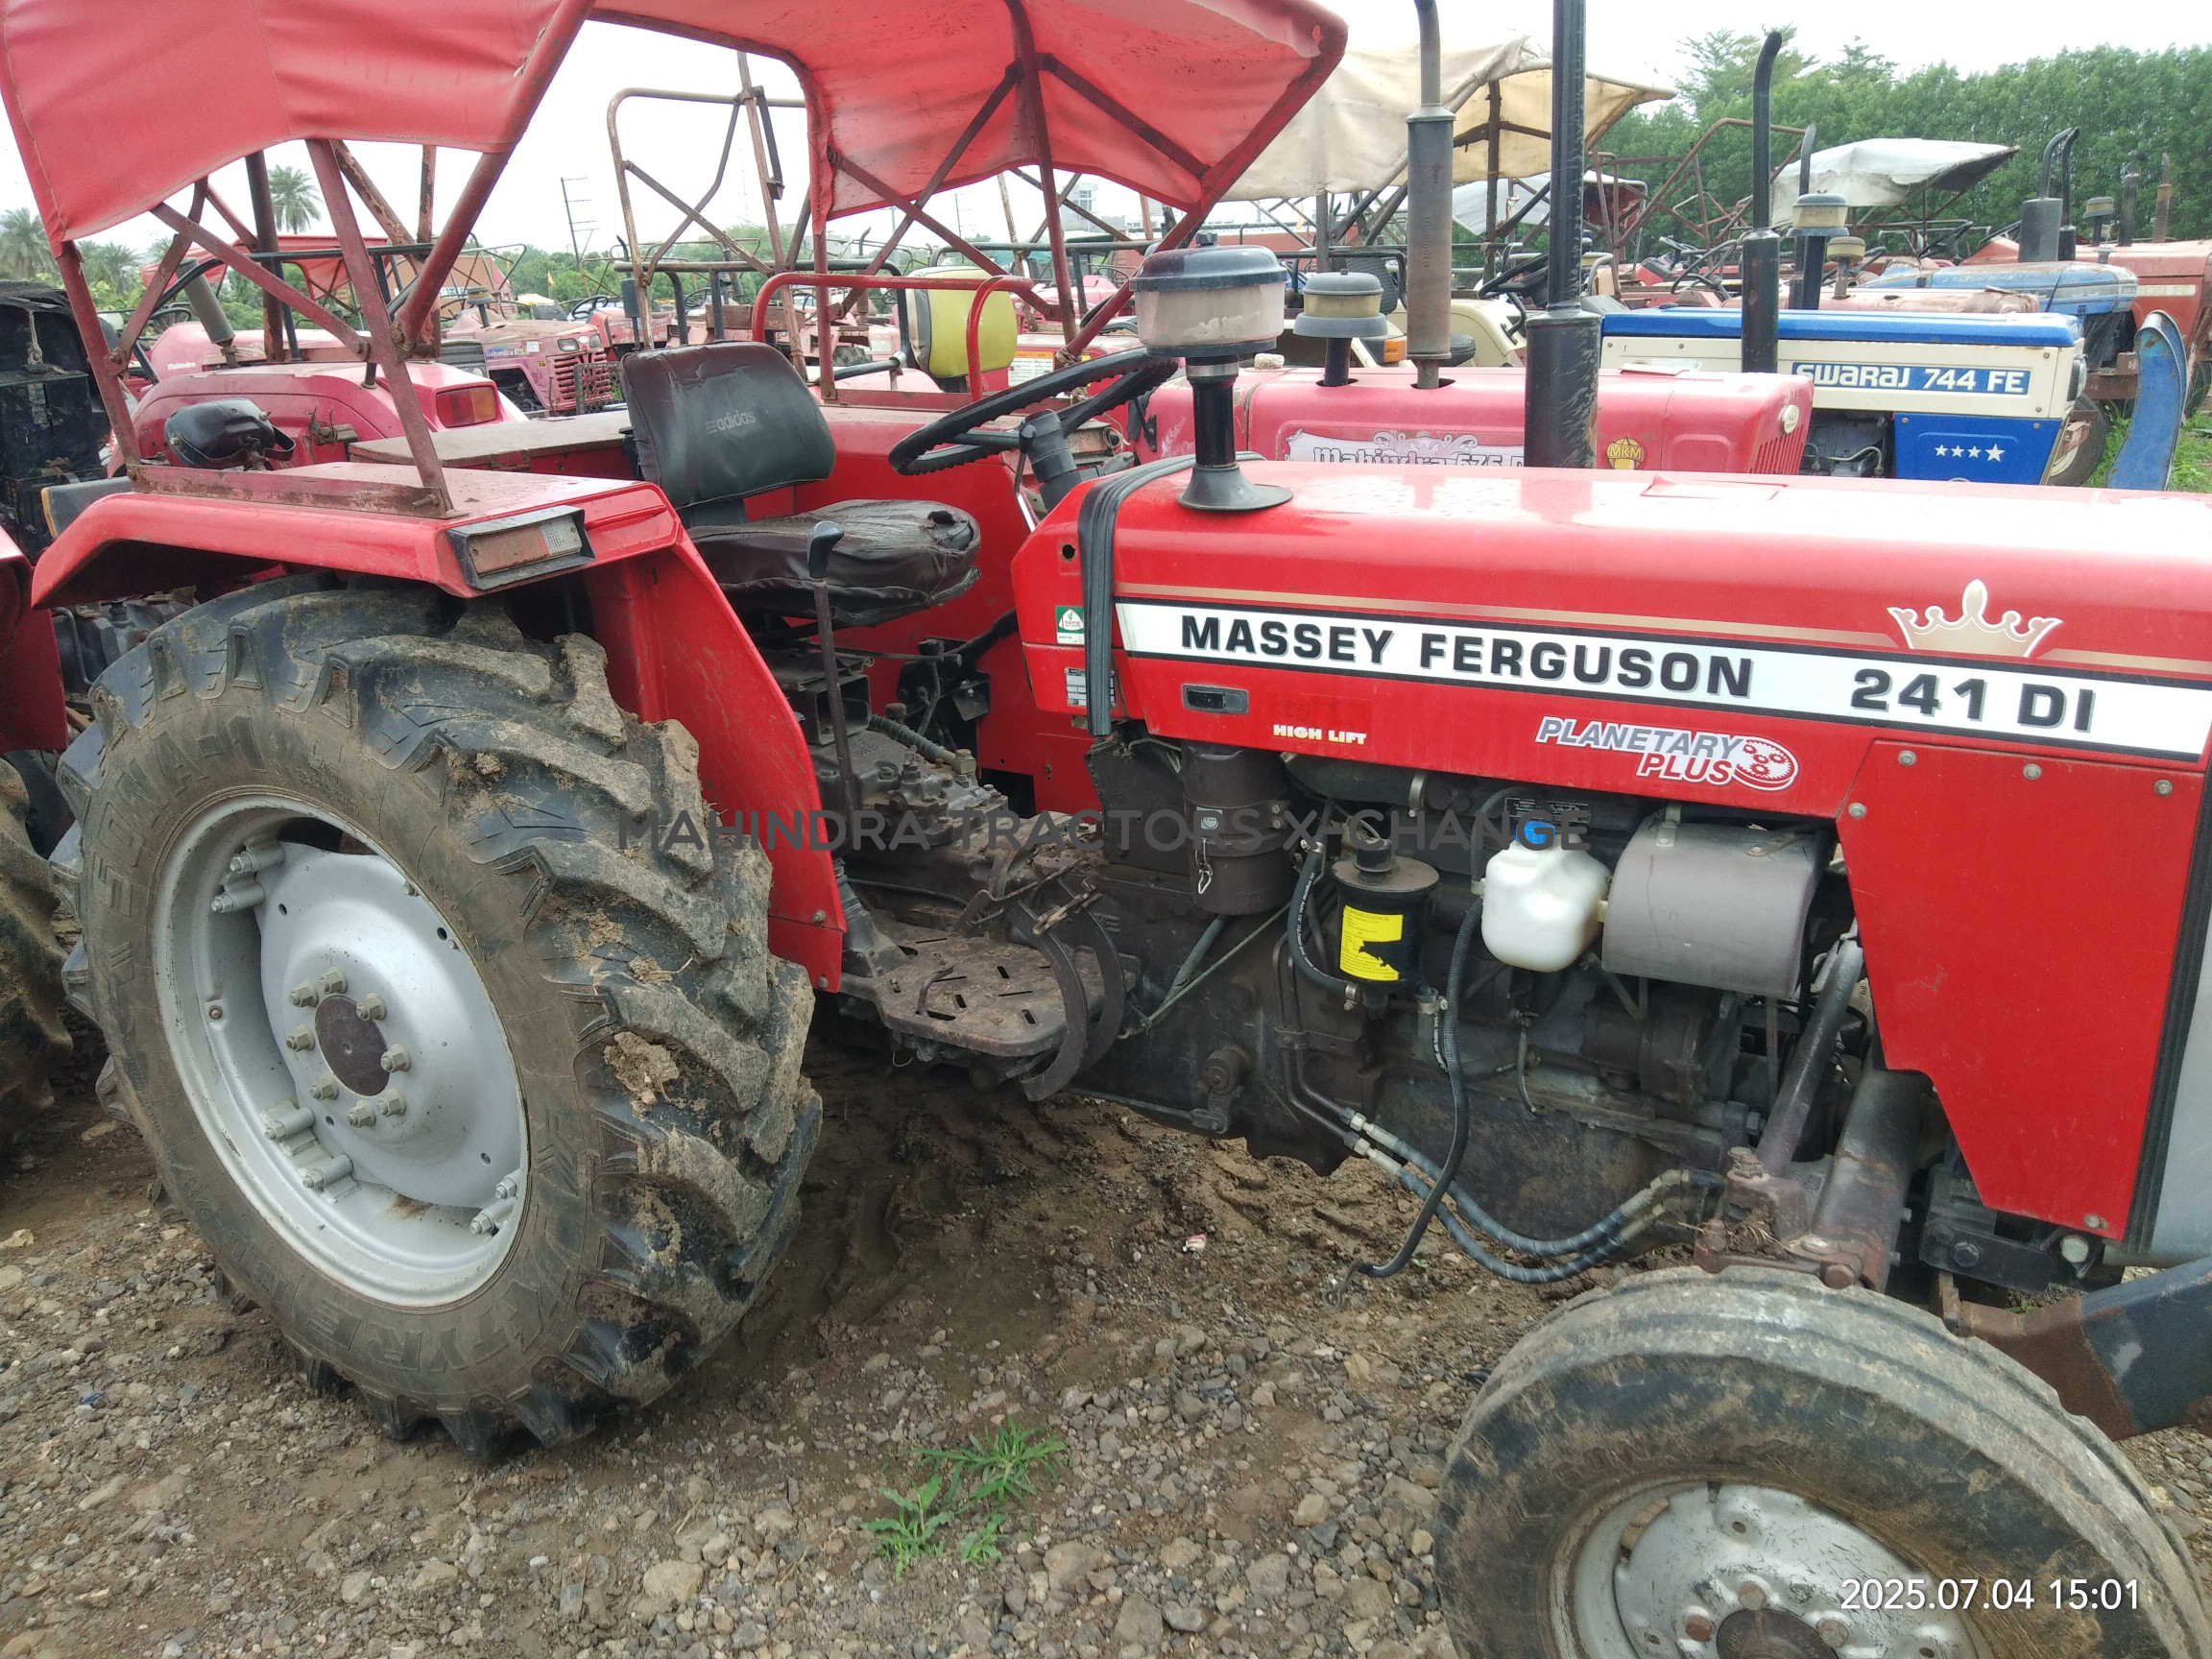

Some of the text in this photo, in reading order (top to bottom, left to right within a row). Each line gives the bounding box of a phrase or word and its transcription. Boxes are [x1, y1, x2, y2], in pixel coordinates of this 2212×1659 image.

[1922, 368, 1977, 391] 744
[1986, 371, 2025, 393] FE
[716, 409, 757, 431] adidas
[1608, 444, 1643, 460] MKM
[1181, 614, 2097, 733] MASSEY FERGUSON 241 DI
[1272, 723, 1367, 745] HIGH LIFT
[1537, 717, 1745, 759] PLANETARY
[1637, 752, 1733, 784] PLUS
